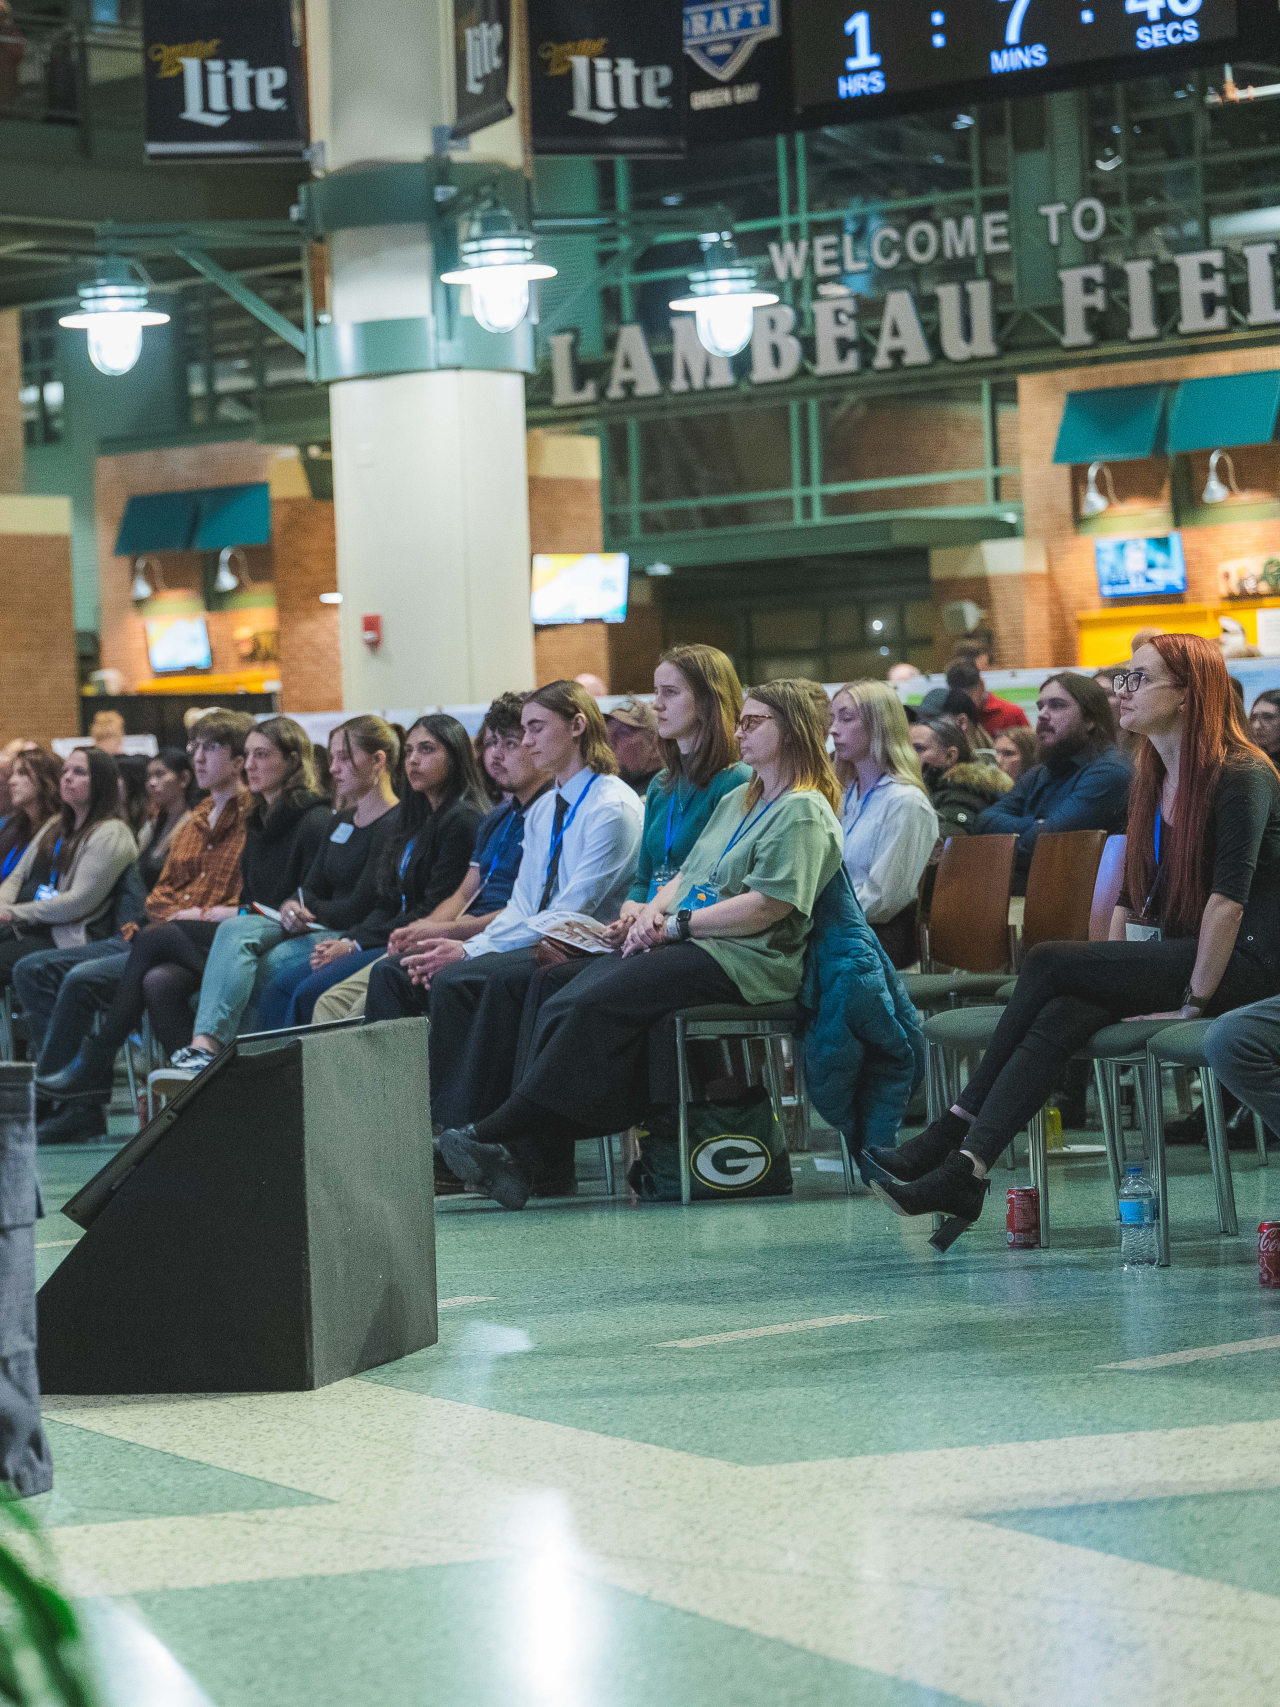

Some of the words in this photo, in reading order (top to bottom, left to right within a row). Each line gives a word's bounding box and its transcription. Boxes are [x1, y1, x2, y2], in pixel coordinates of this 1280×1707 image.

[843, 10, 882, 71] 1
[998, 0, 1029, 46] 7
[990, 43, 1048, 74] MINS
[1135, 18, 1200, 50] SECS
[179, 57, 288, 127] Lite
[568, 55, 674, 125] Lite
[837, 70, 886, 99] HRS
[769, 211, 1010, 282] WELCOME
[1039, 198, 1106, 246] TO
[549, 279, 999, 405] LAMBEAU
[696, 1139, 766, 1185] G
